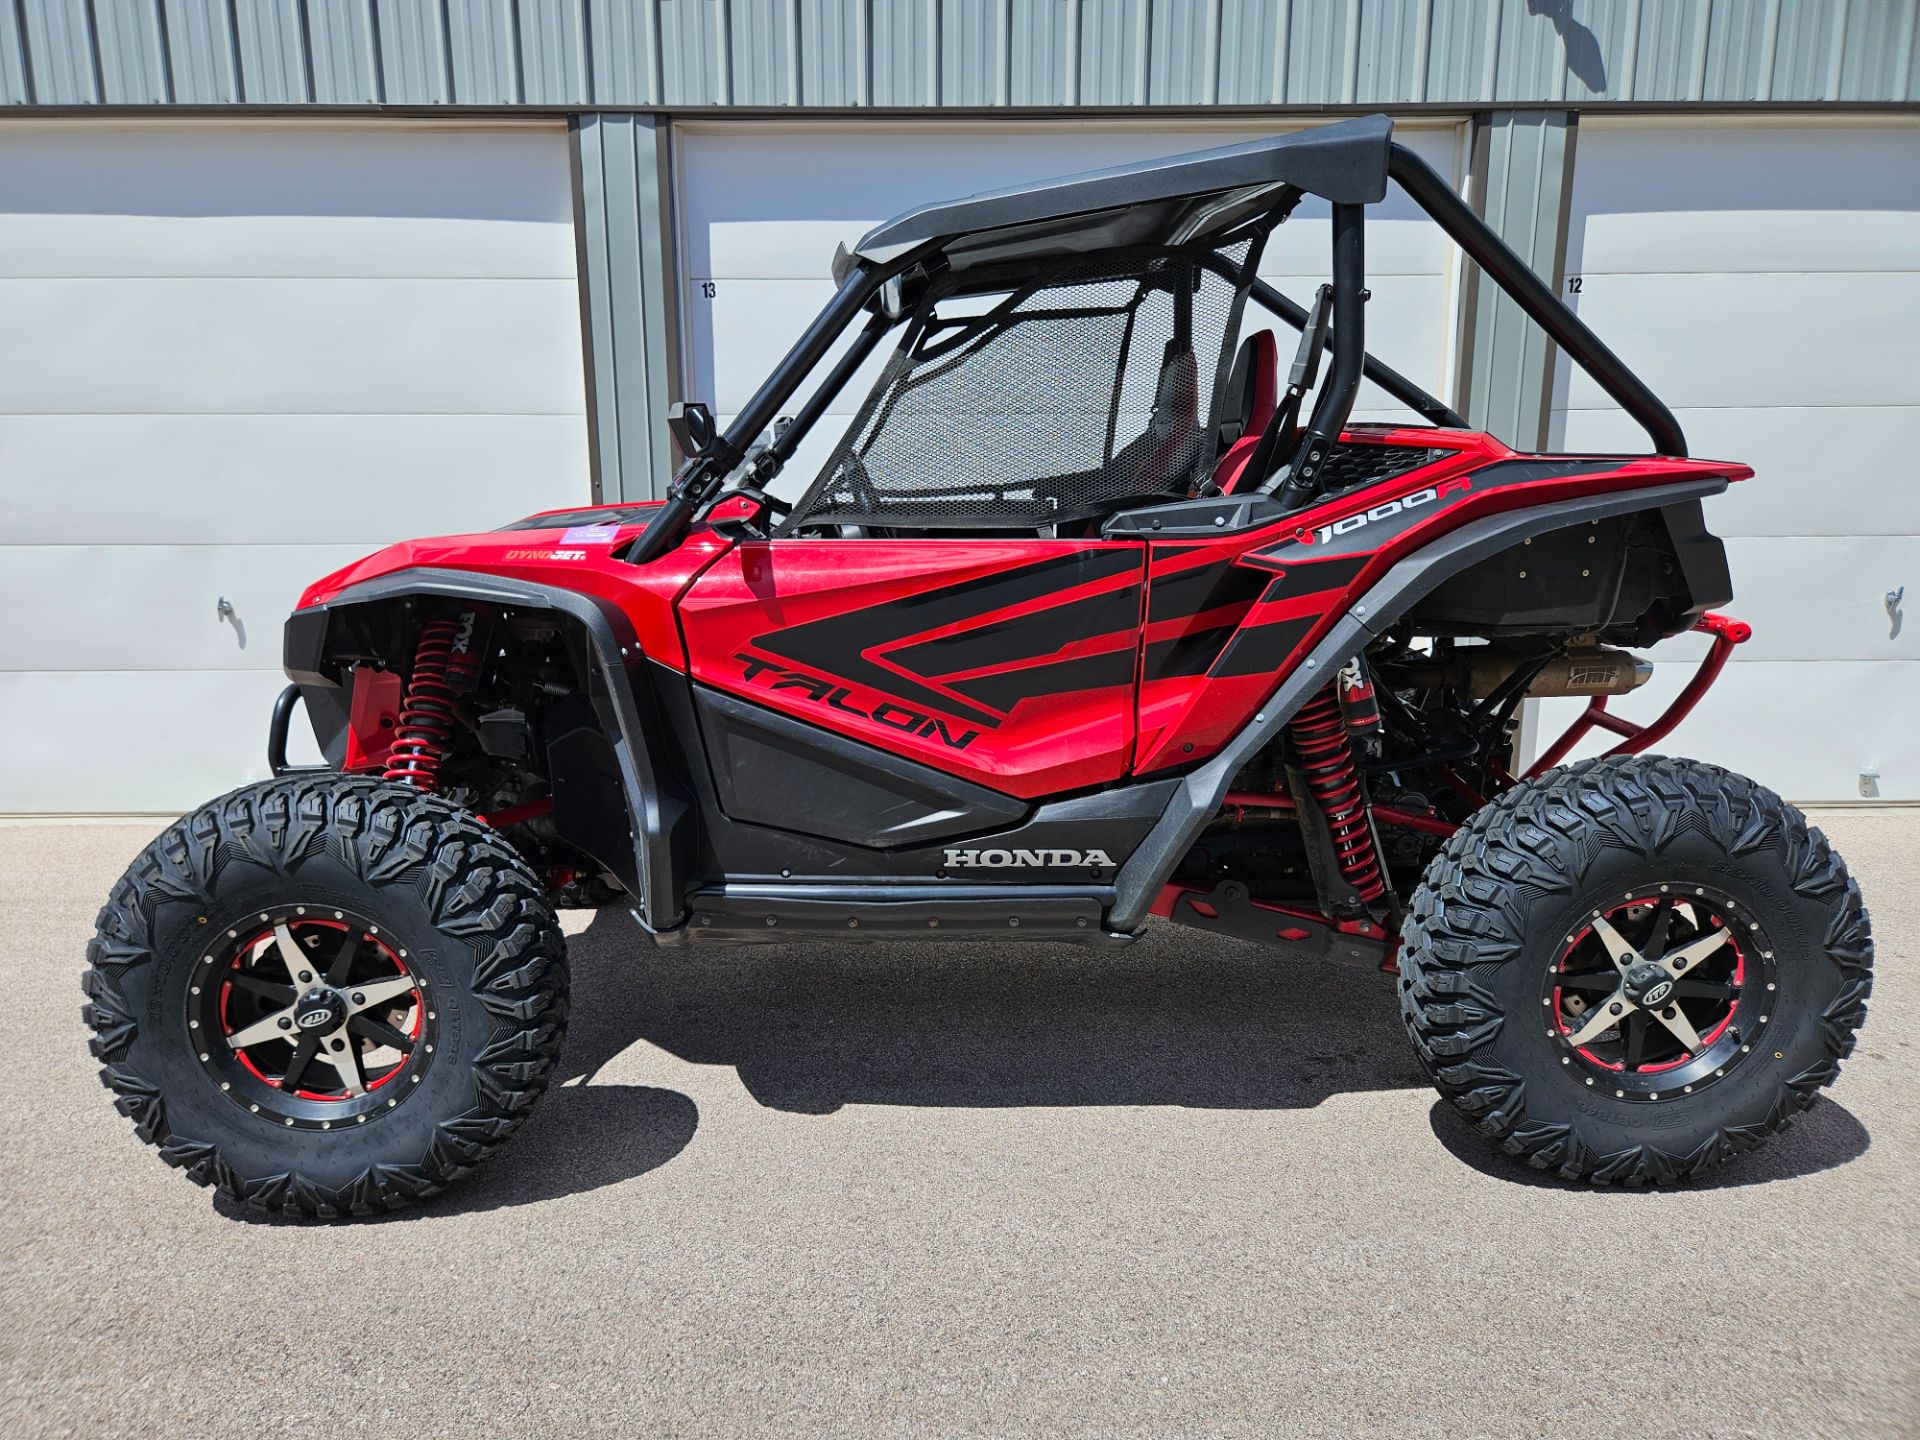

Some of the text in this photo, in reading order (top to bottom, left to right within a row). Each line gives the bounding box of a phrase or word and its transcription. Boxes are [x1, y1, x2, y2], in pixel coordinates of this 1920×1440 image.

[701, 282, 716, 299] 13
[1567, 277, 1583, 294] 12
[1318, 476, 1472, 545] 1000R
[451, 611, 476, 654] FOX
[1341, 656, 1364, 692] OX
[732, 652, 981, 750] TALON
[943, 849, 1117, 868] HONDA
[1646, 983, 1669, 1003] ITP
[301, 1011, 329, 1026] ITP
